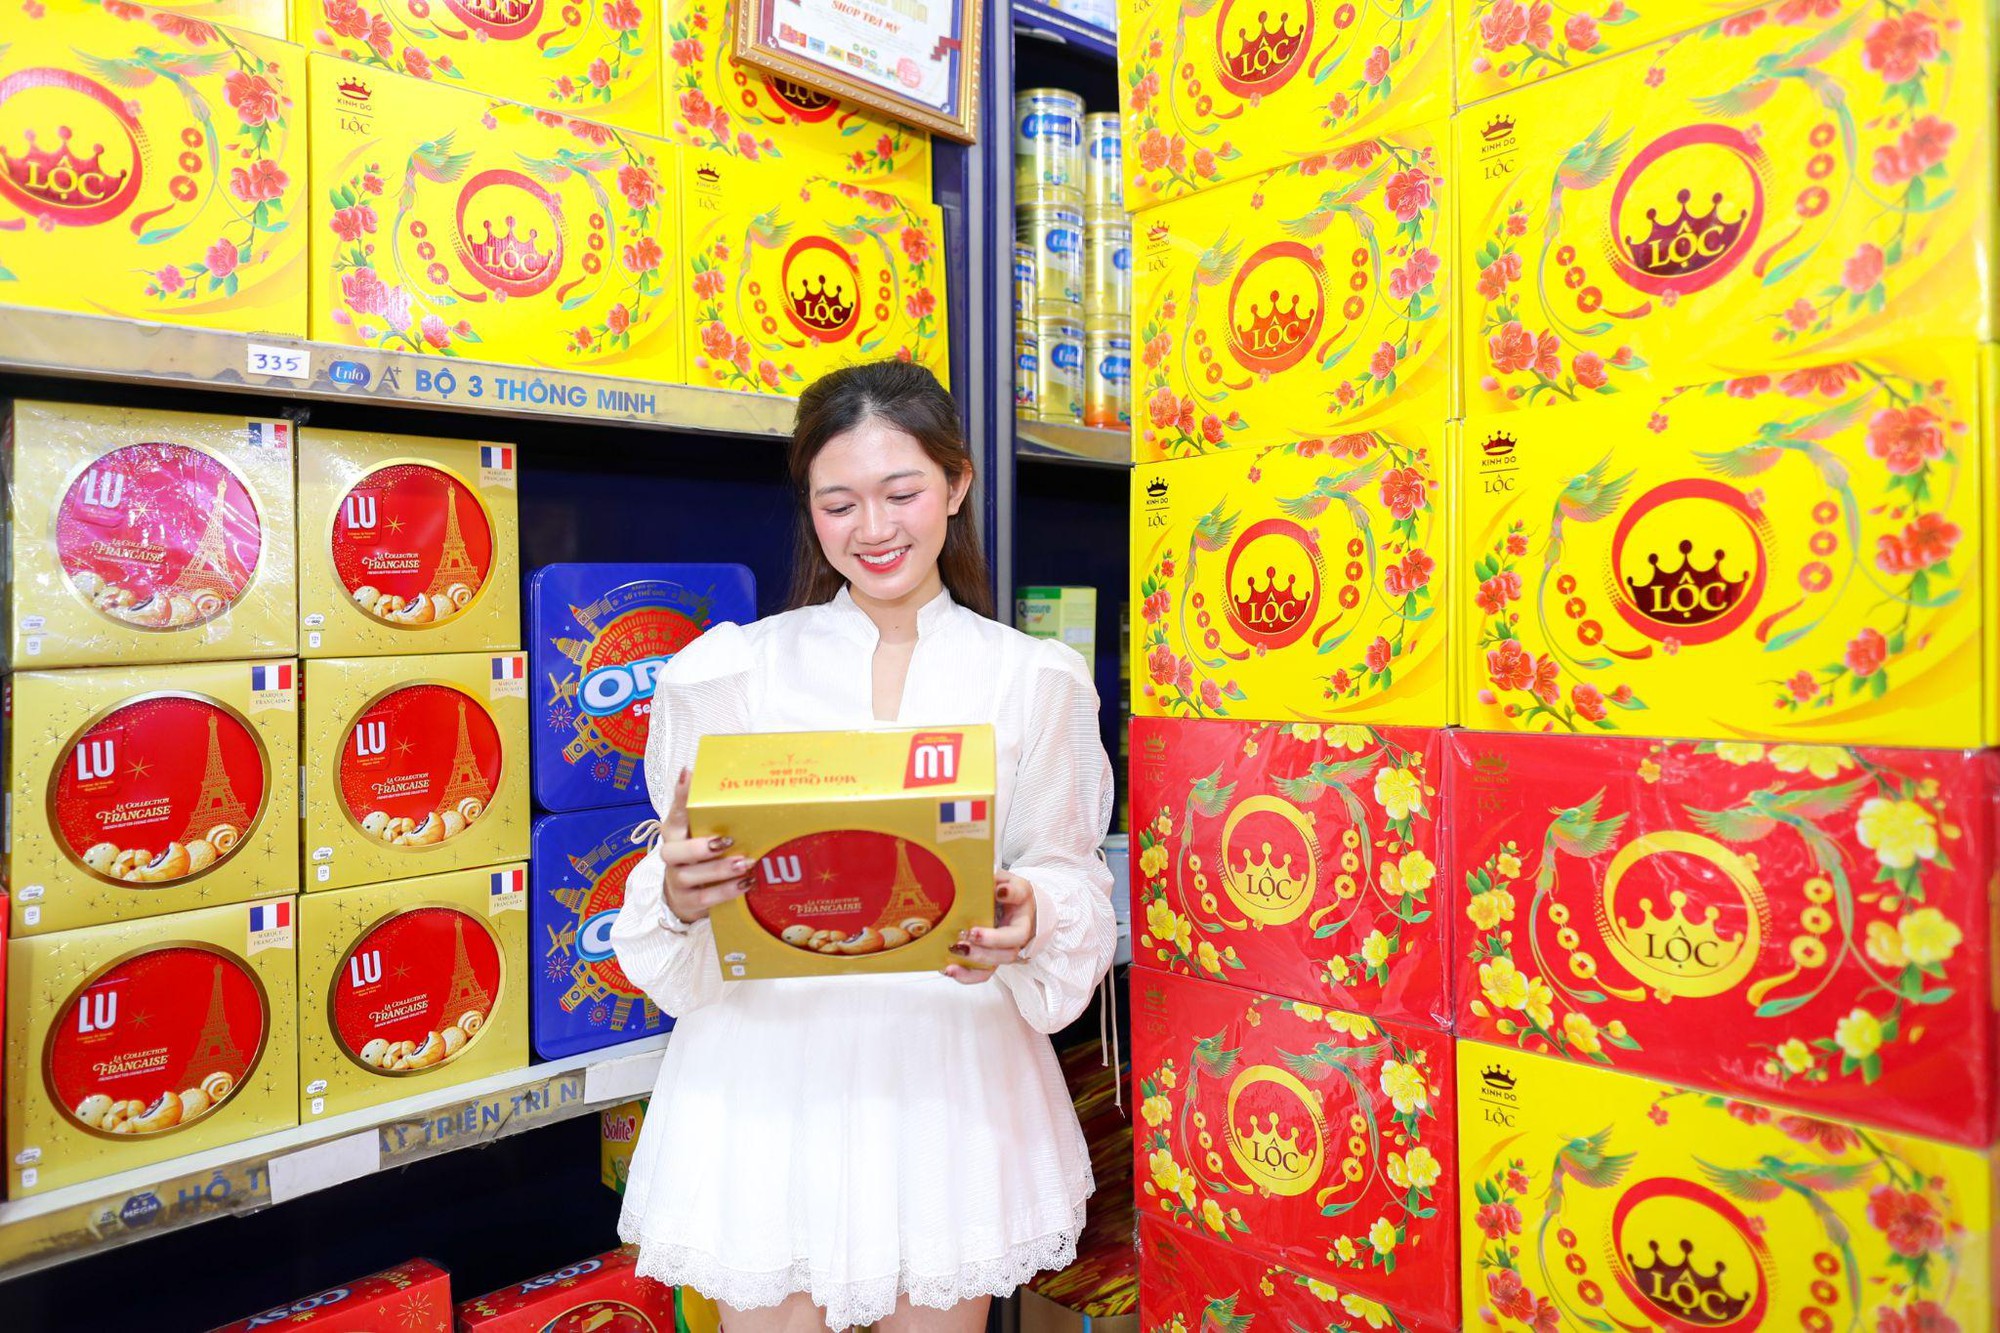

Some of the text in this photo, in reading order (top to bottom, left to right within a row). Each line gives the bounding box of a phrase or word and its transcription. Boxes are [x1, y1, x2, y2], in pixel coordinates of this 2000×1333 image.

[1241, 36, 1290, 76] LỘC
[341, 116, 370, 135] LỘC
[1482, 141, 1502, 153] KINH
[25, 155, 105, 200] LỘC
[1485, 158, 1515, 180] LỘC
[486, 241, 539, 276] LỘC
[1649, 220, 1725, 268] LỘC
[804, 295, 843, 326] LỘC
[1254, 316, 1299, 351] LỘC
[253, 353, 302, 372] 335
[415, 367, 457, 399] BỘ
[468, 375, 484, 398] 3
[495, 377, 588, 408] THÔNG
[597, 388, 656, 415] MINH
[1481, 457, 1502, 466] KINH
[84, 469, 124, 508] LU
[1485, 473, 1515, 495] LỘC
[347, 497, 376, 528] LU
[1148, 512, 1168, 529] LỘC
[385, 551, 419, 560] COLLECTION
[1249, 592, 1296, 628] LỘC
[1651, 571, 1727, 618] LỘC
[584, 659, 668, 709] OR
[633, 703, 651, 717] Se
[356, 721, 386, 756] LU
[77, 740, 115, 780] LU
[394, 772, 429, 783] COLLECTION
[914, 744, 954, 780] LU
[125, 797, 170, 809] COLLECTION
[762, 855, 802, 885] LU
[1246, 867, 1291, 902] LỘC
[1645, 925, 1720, 969] LỘC
[351, 950, 381, 988] LU
[78, 992, 117, 1033] LU
[391, 993, 428, 1009] COLLECTION
[121, 1047, 168, 1061] COLLECTION
[1481, 1086, 1502, 1098] KINH
[602, 1111, 631, 1141] Solite
[1485, 1107, 1515, 1128] LỘC
[1252, 1137, 1298, 1173] LỘC
[520, 1259, 603, 1295] COSY
[246, 1287, 354, 1331] COSY
[1651, 1269, 1728, 1321] LỘC
